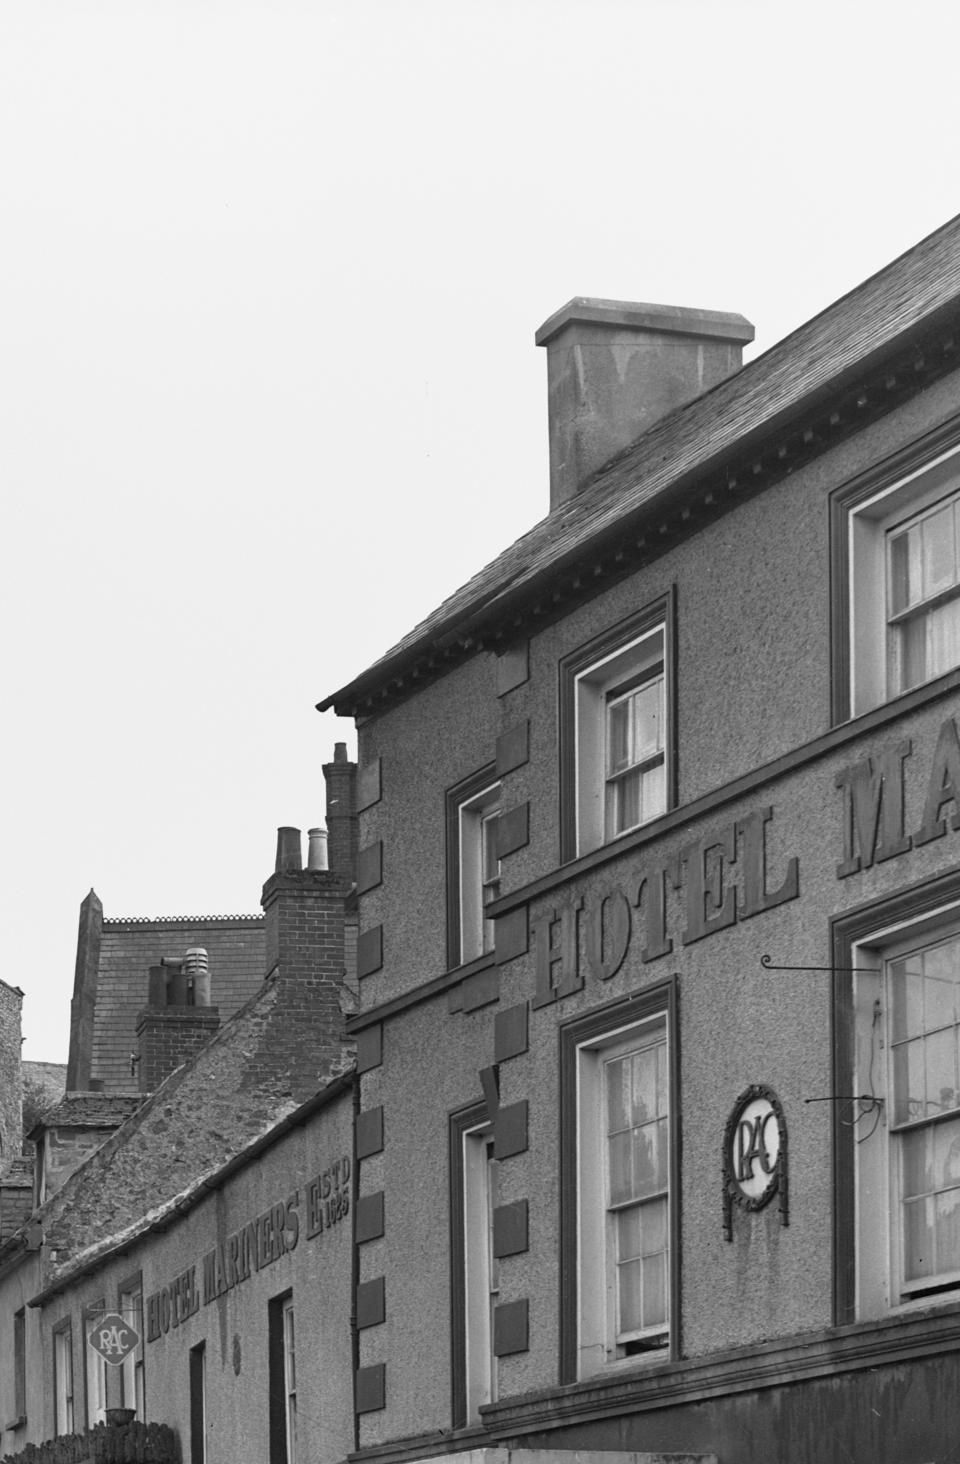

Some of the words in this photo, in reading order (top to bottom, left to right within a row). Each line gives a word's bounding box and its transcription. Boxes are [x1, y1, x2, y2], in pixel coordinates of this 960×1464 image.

[531, 805, 800, 1012] HOTEL
[98, 1325, 129, 1355] RAC
[146, 1264, 200, 1344] HOTEL
